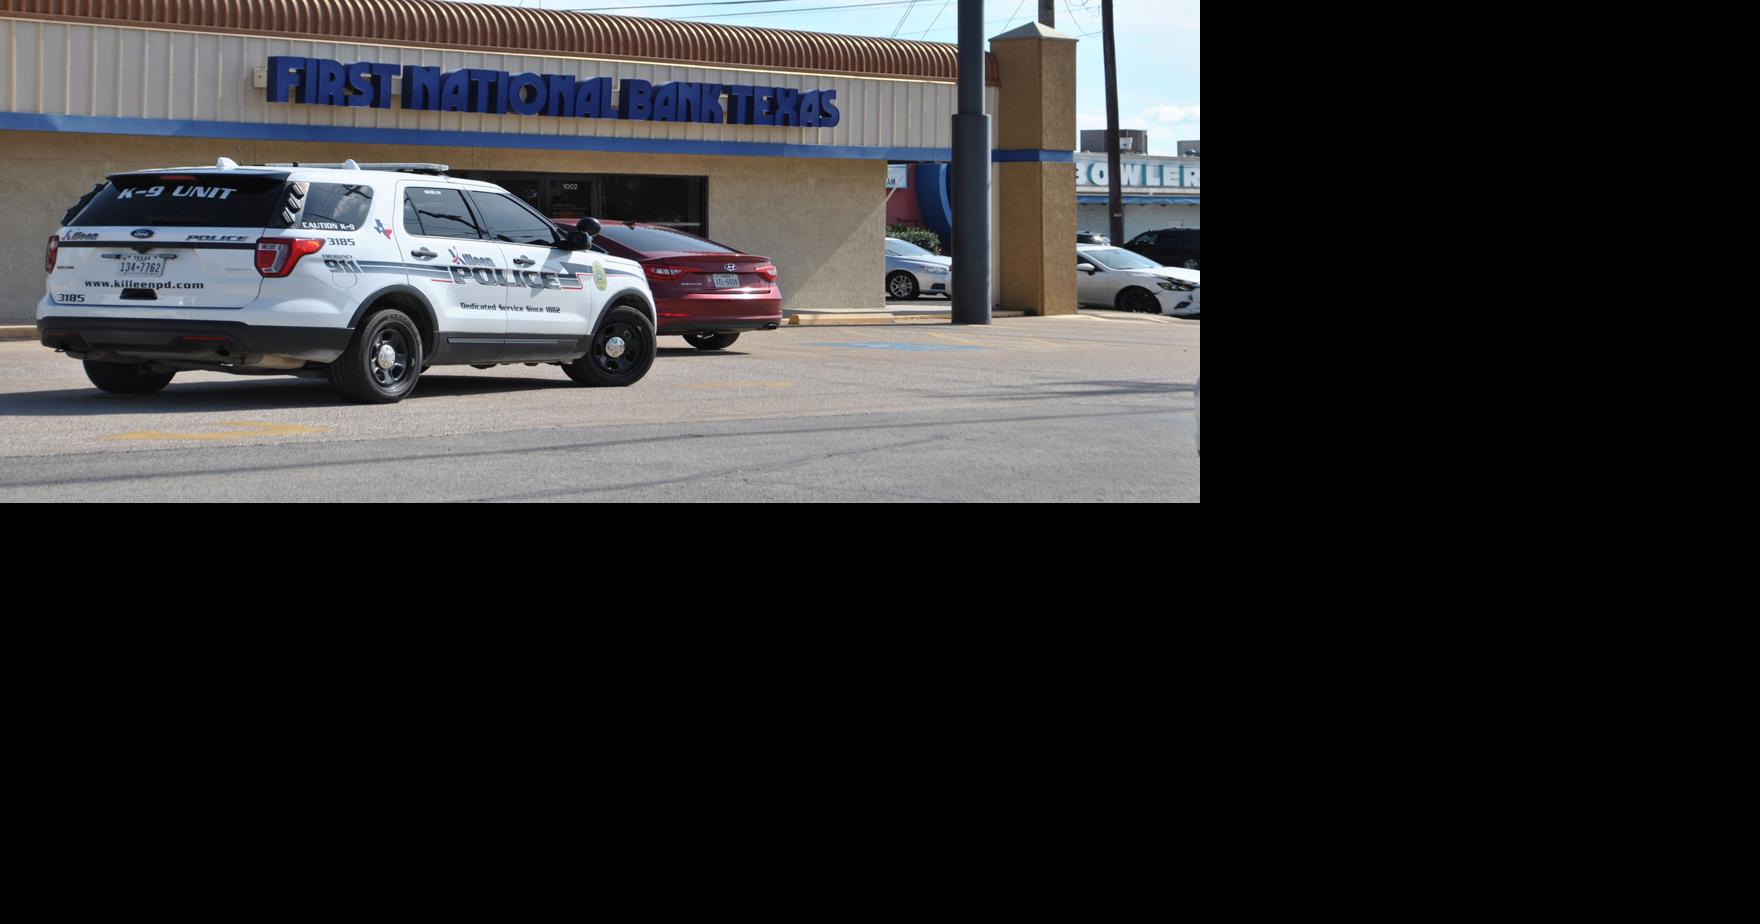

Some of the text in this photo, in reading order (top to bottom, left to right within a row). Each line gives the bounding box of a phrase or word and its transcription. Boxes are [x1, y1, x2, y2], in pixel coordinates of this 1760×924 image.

[267, 56, 840, 128] FIRST NATIONAL BANK TEXAS
[117, 185, 237, 200] K-9 UNIT
[302, 222, 355, 231] CAUTION K-9
[185, 234, 249, 242] POLICE
[327, 237, 356, 247] 3185
[324, 259, 363, 274] 911
[448, 265, 562, 291] POLICE
[84, 280, 204, 290] www.killeenpd.com
[58, 293, 86, 303] 3185
[460, 302, 497, 311] Dedicated
[498, 304, 524, 312] Service
